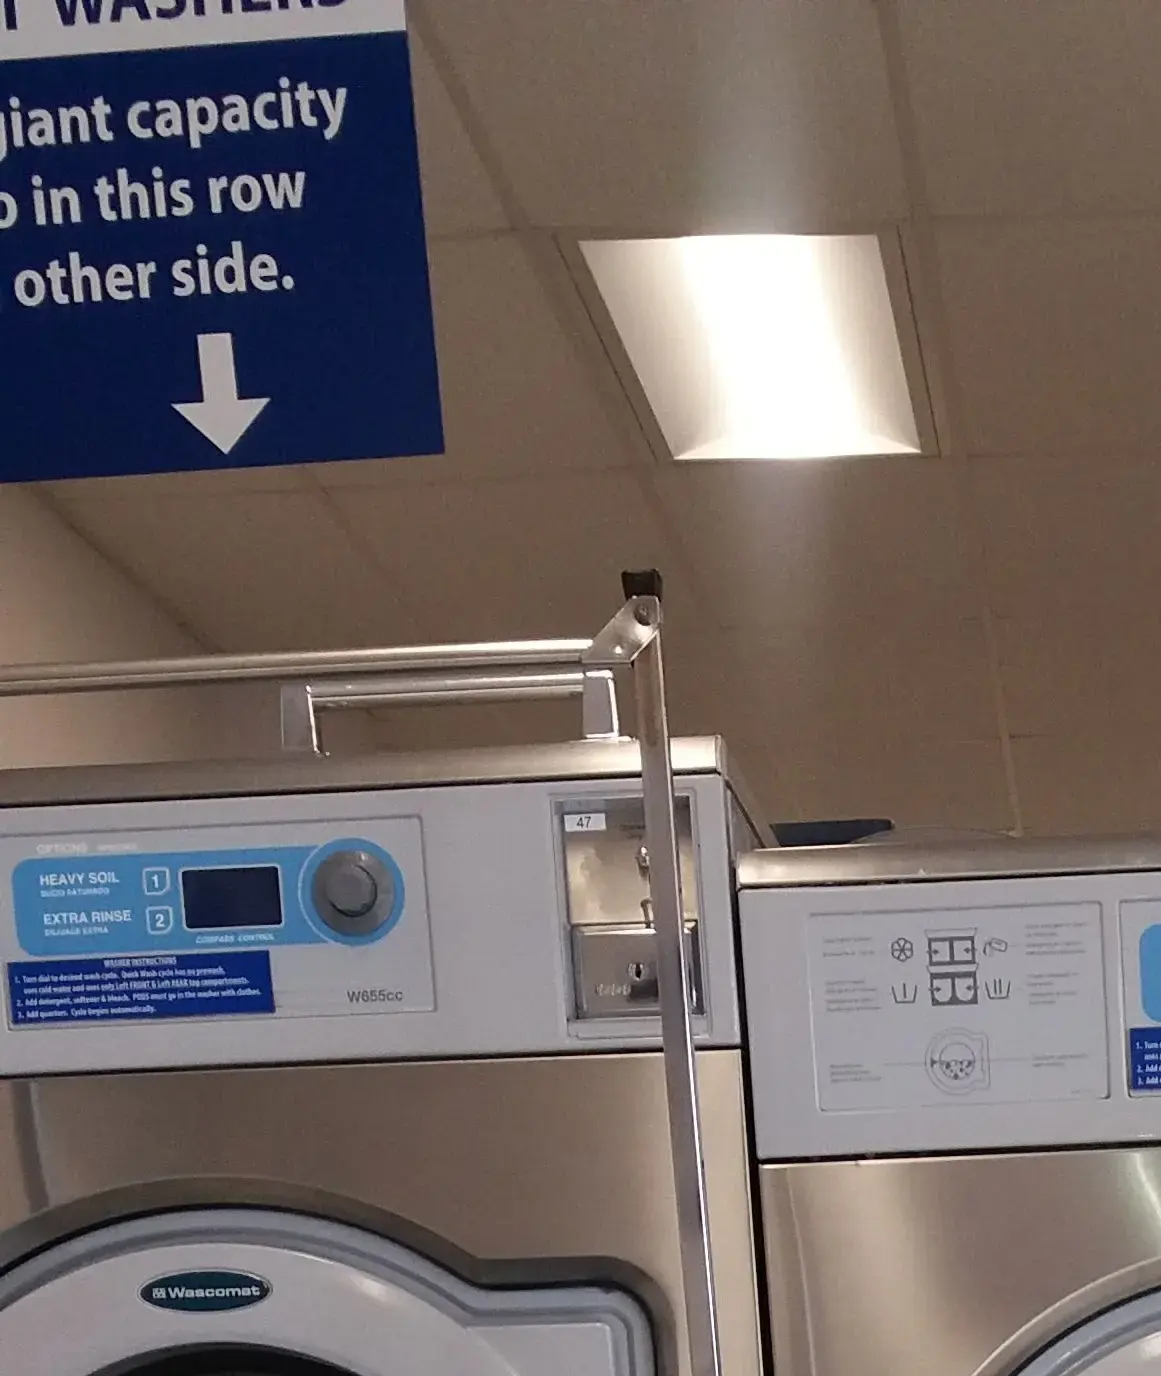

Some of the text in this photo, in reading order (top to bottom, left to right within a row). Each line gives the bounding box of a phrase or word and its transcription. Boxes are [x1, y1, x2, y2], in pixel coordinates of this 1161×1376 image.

[0, 77, 347, 161] iant capacity
[31, 175, 82, 226] in
[94, 167, 194, 221] this
[209, 171, 305, 214] row
[14, 241, 294, 307] other side.
[576, 816, 591, 829] 47
[40, 872, 119, 886] HEAVY SOIL
[152, 875, 159, 888] 1
[43, 910, 131, 924] EXTRA RINSE
[155, 914, 164, 927] 2
[347, 989, 403, 1003] W655cc
[168, 1285, 260, 1299] Wascomat
